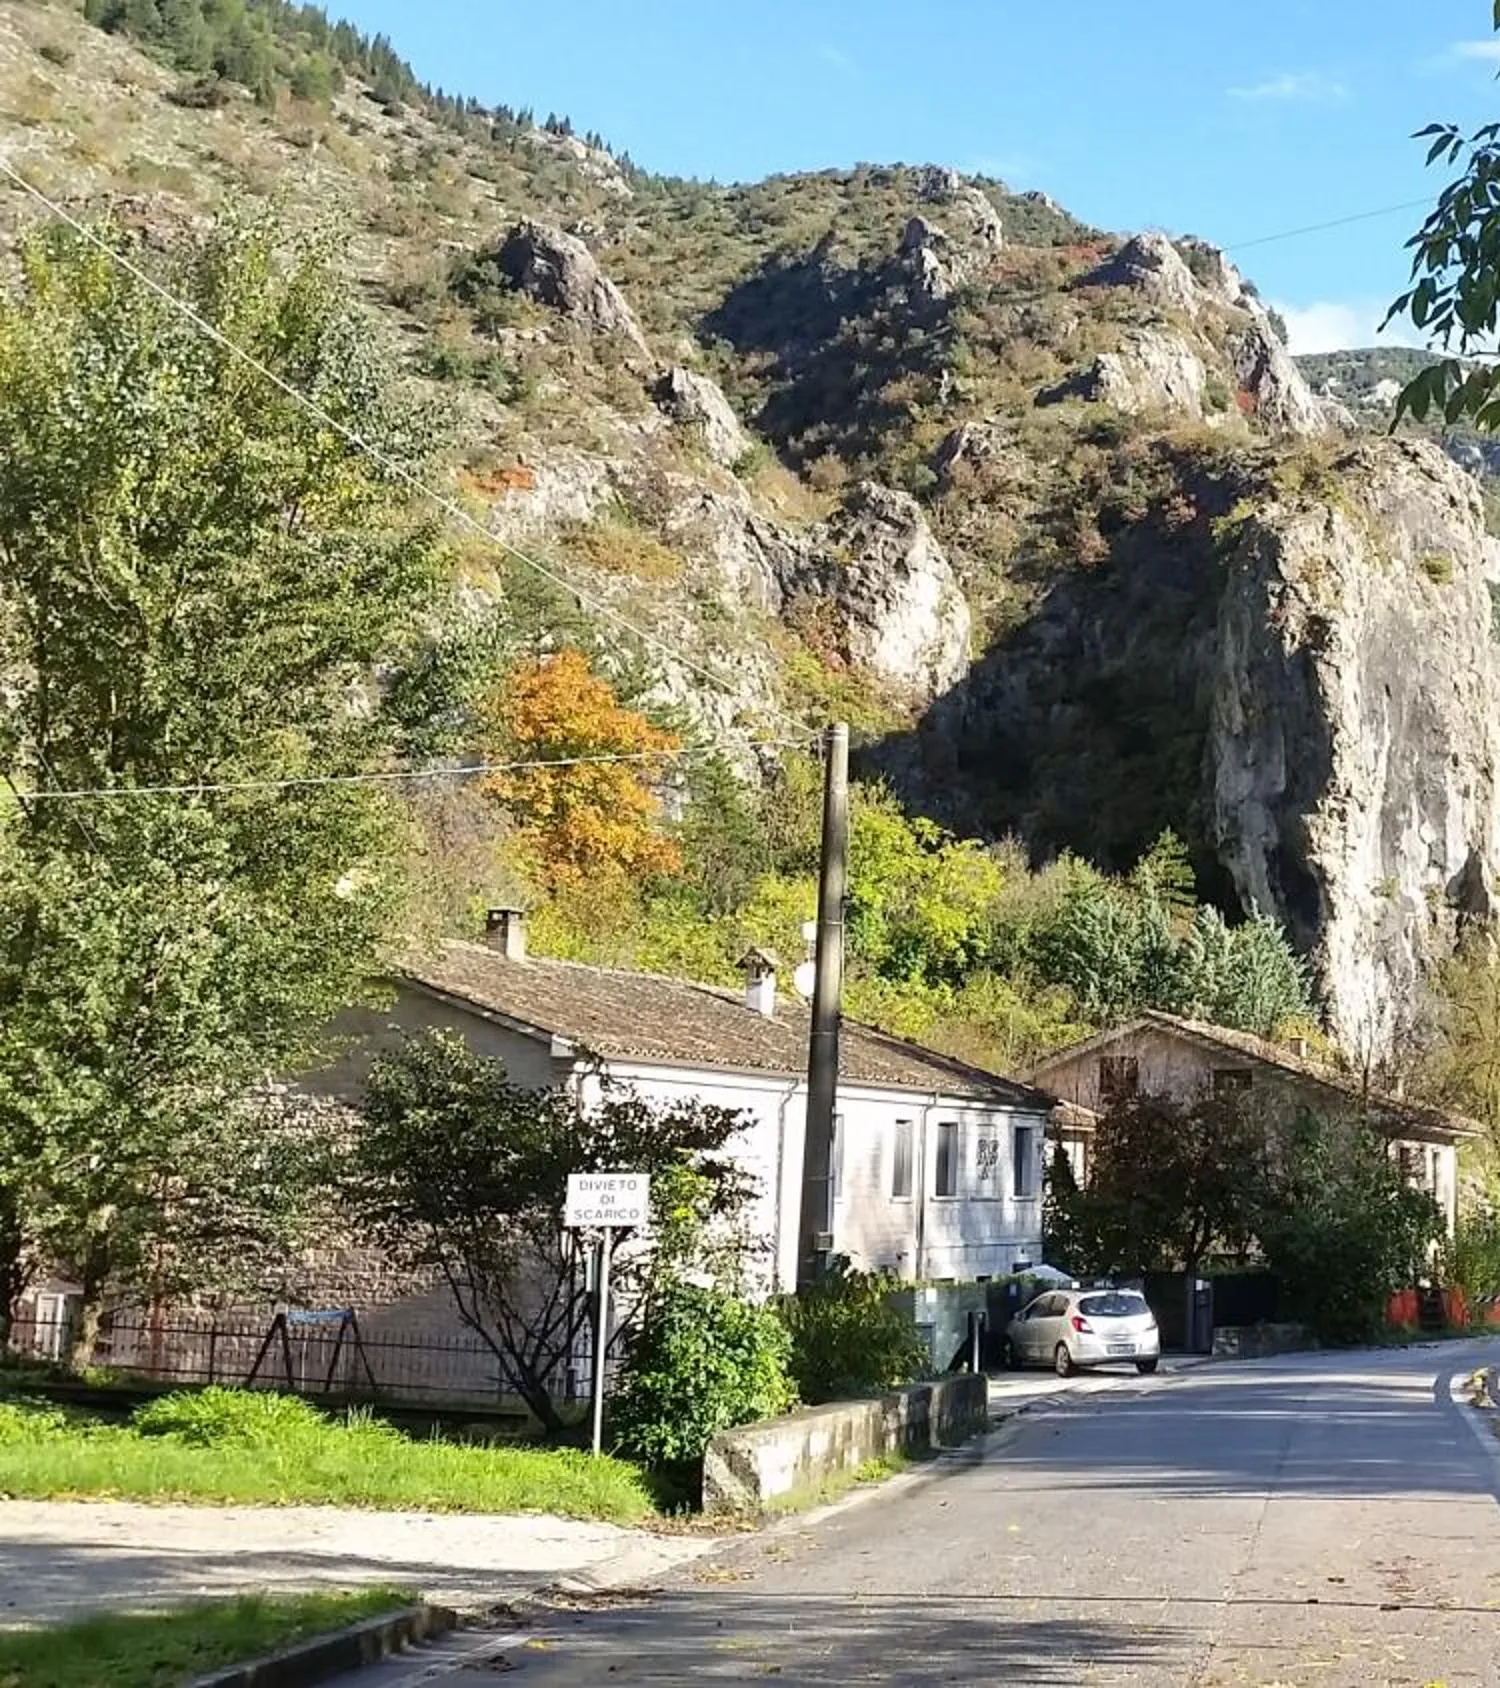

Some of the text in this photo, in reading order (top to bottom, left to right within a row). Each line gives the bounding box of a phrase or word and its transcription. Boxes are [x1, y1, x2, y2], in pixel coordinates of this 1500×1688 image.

[579, 1180, 637, 1191] DIVIETO
[601, 1194, 615, 1205] DI
[574, 1208, 639, 1220] SCARICO
